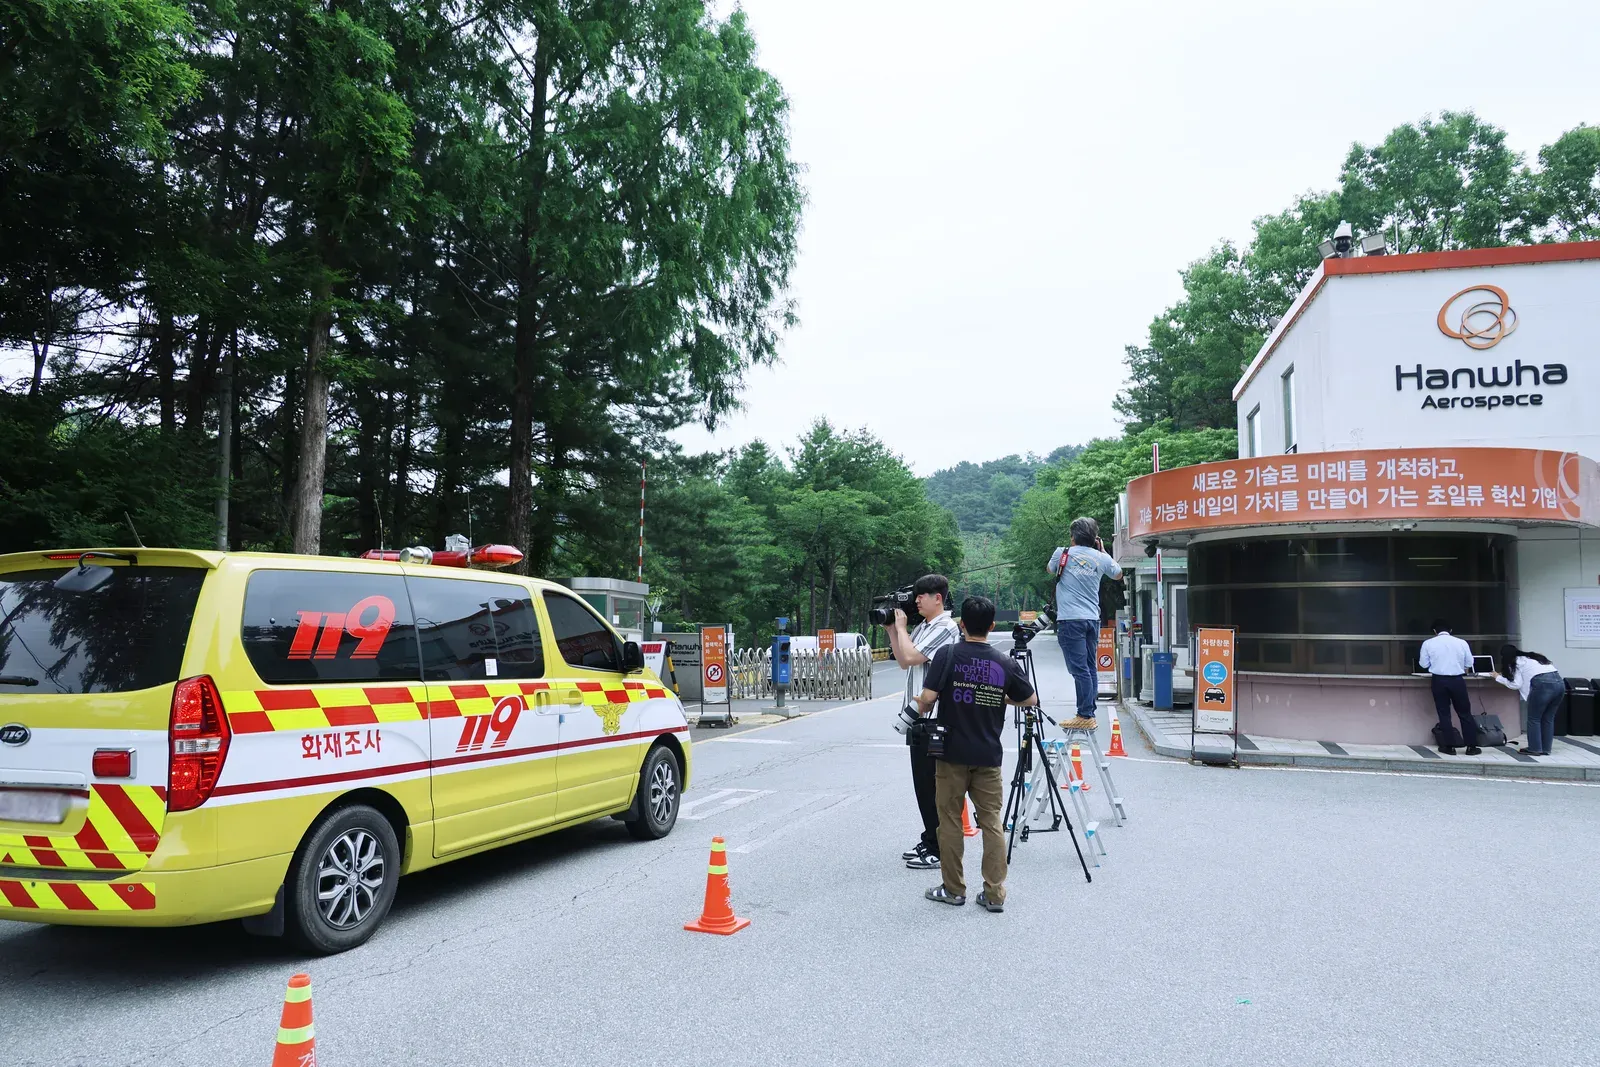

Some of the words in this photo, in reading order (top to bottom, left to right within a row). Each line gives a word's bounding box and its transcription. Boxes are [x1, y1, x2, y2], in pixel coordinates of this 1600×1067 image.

[1396, 359, 1568, 391] Hanwha
[1421, 394, 1543, 410] Aerospace
[1192, 469, 1238, 493] 새로운
[1244, 464, 1299, 487] 기술로
[1307, 457, 1368, 483] 미래를
[1376, 457, 1464, 480] 개척하고,
[1139, 506, 1153, 526] 지속
[1155, 500, 1189, 523] 가능한
[1193, 494, 1238, 518] 내일의
[1245, 489, 1299, 513] 가치를
[1307, 486, 1368, 510] 만들어
[1377, 485, 1418, 508] 가는
[1426, 484, 1485, 507] 초일류
[1491, 484, 1526, 508] 혁신
[1531, 487, 1558, 508] 기업
[287, 595, 396, 660] 119
[671, 643, 703, 651] Hanwh
[1202, 639, 1230, 647] 차량창문
[954, 663, 989, 677] NORTH
[971, 657, 989, 668] THE
[964, 672, 989, 684] FACE
[953, 681, 979, 690] Berkeley,
[979, 684, 1004, 694] California
[953, 688, 973, 704] 66
[455, 695, 523, 753] 119
[1, 729, 26, 740] 119
[301, 729, 382, 760] 화재조사
